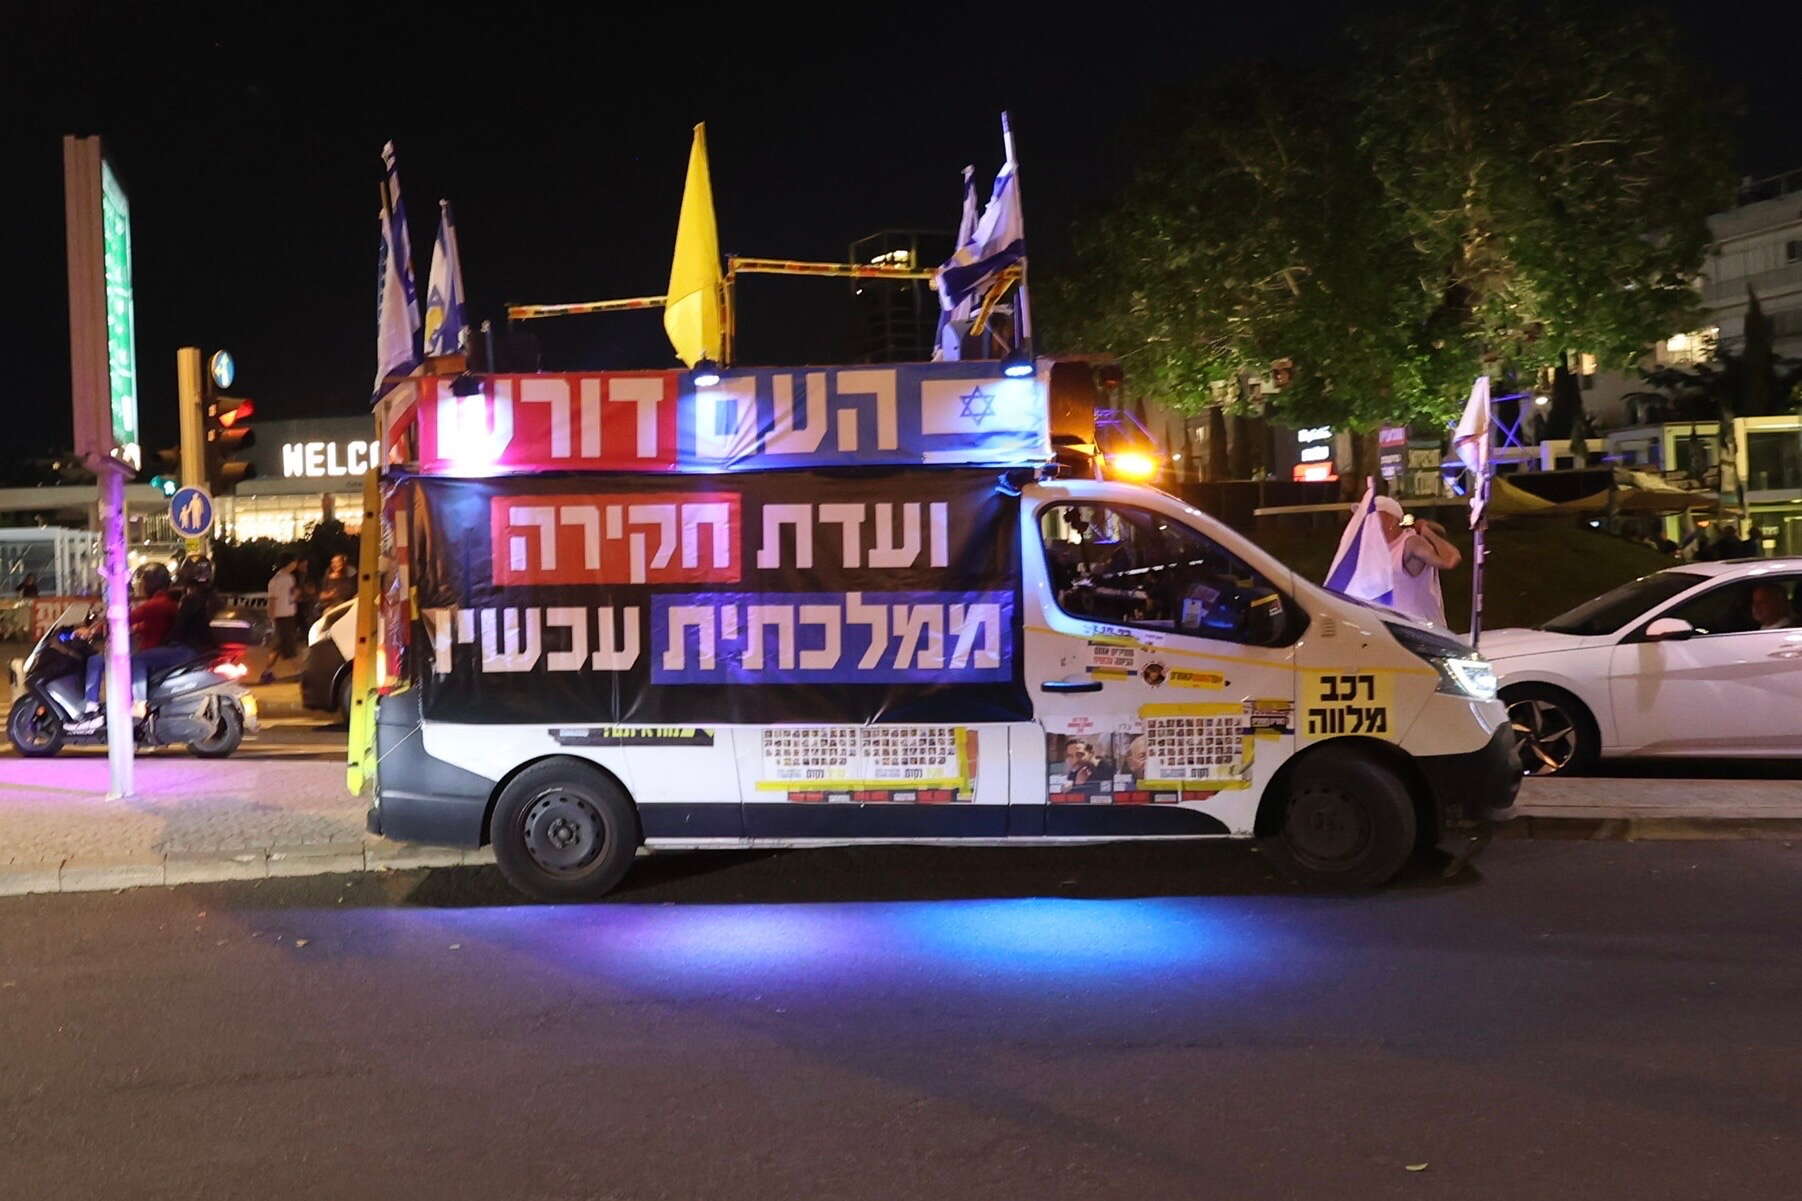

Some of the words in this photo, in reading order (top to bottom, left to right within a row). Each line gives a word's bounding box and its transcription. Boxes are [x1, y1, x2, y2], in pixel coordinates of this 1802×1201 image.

[437, 377, 664, 459] דורש
[695, 369, 898, 458] העם
[508, 503, 731, 584] חקירה
[757, 502, 949, 570] ועדת
[421, 606, 640, 674] עכשיו
[663, 592, 1000, 671] ממלכתית
[1308, 704, 1387, 734] מלווה
[1319, 675, 1375, 702] רכב
